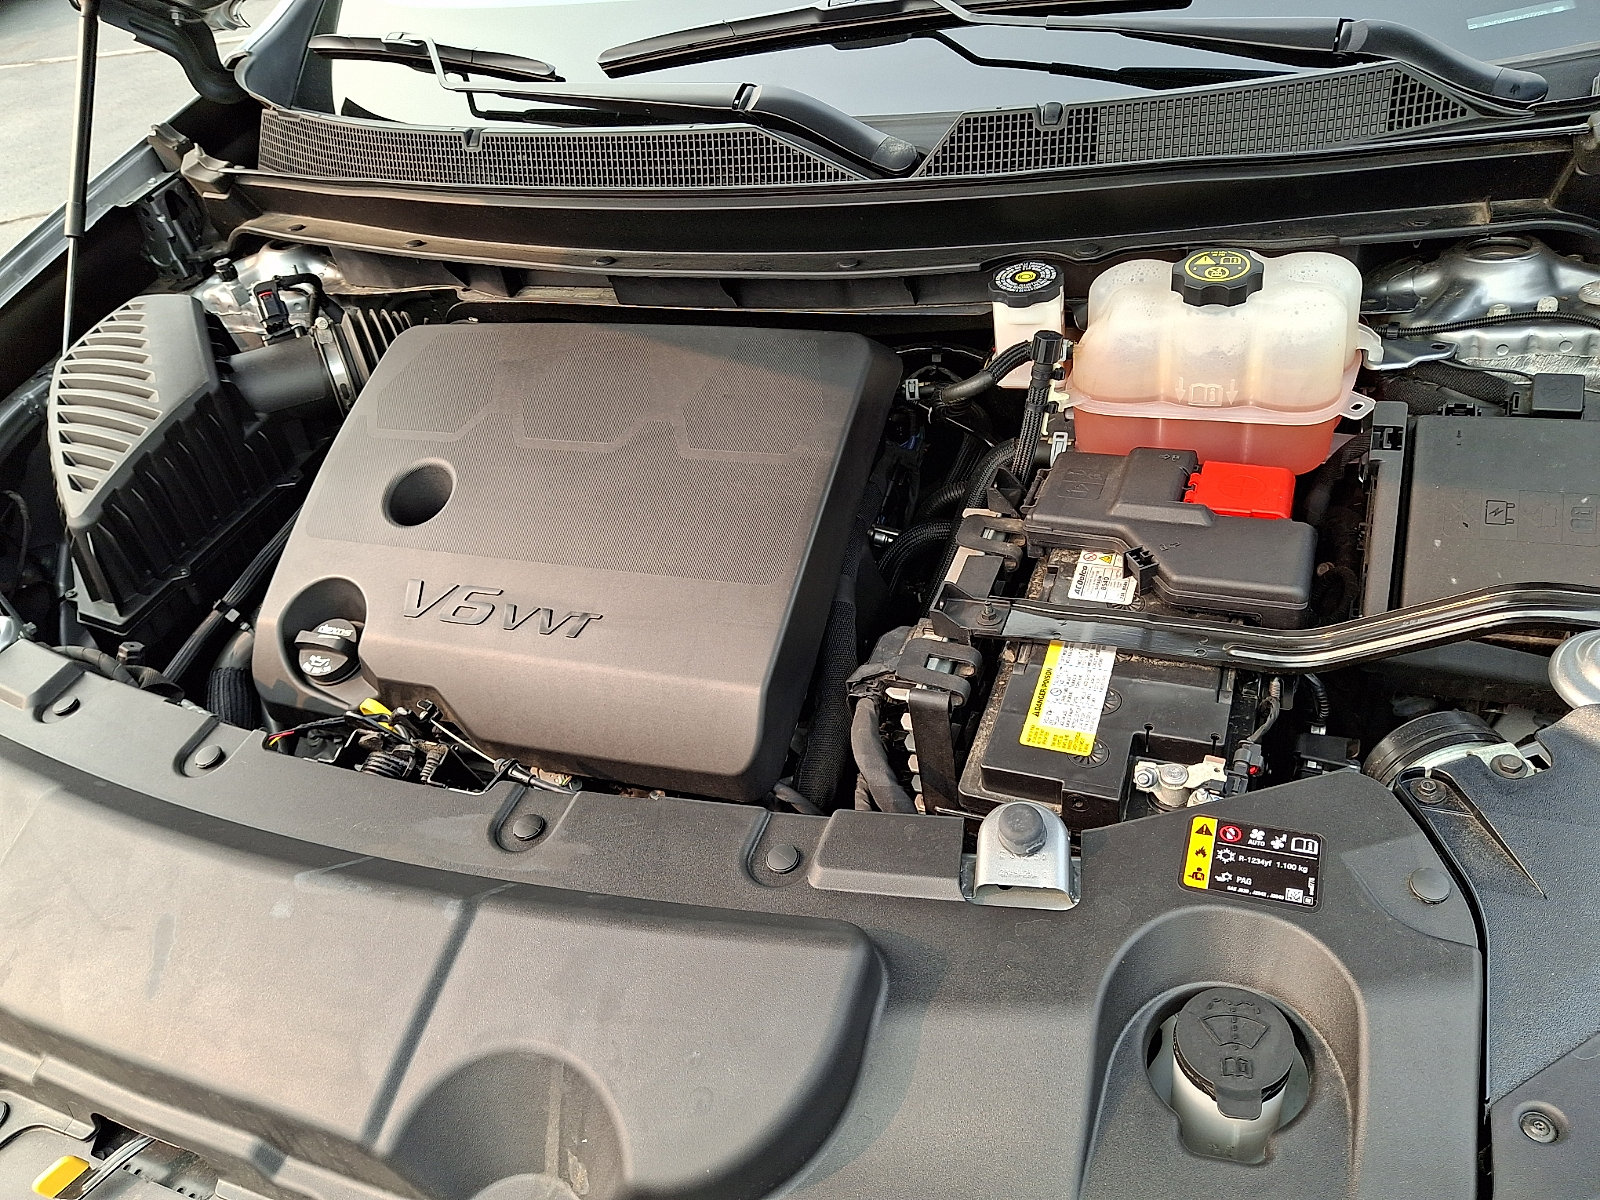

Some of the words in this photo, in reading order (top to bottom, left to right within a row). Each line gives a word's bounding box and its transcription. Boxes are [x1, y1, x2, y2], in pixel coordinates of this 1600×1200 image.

[403, 578, 504, 626] V6
[503, 603, 603, 639] VVT
[1247, 839, 1266, 847] AUTO
[1238, 855, 1273, 868] R-1234yf
[1276, 861, 1297, 871] 1.100
[1298, 864, 1309, 874] kg
[1236, 875, 1252, 886] PAG
